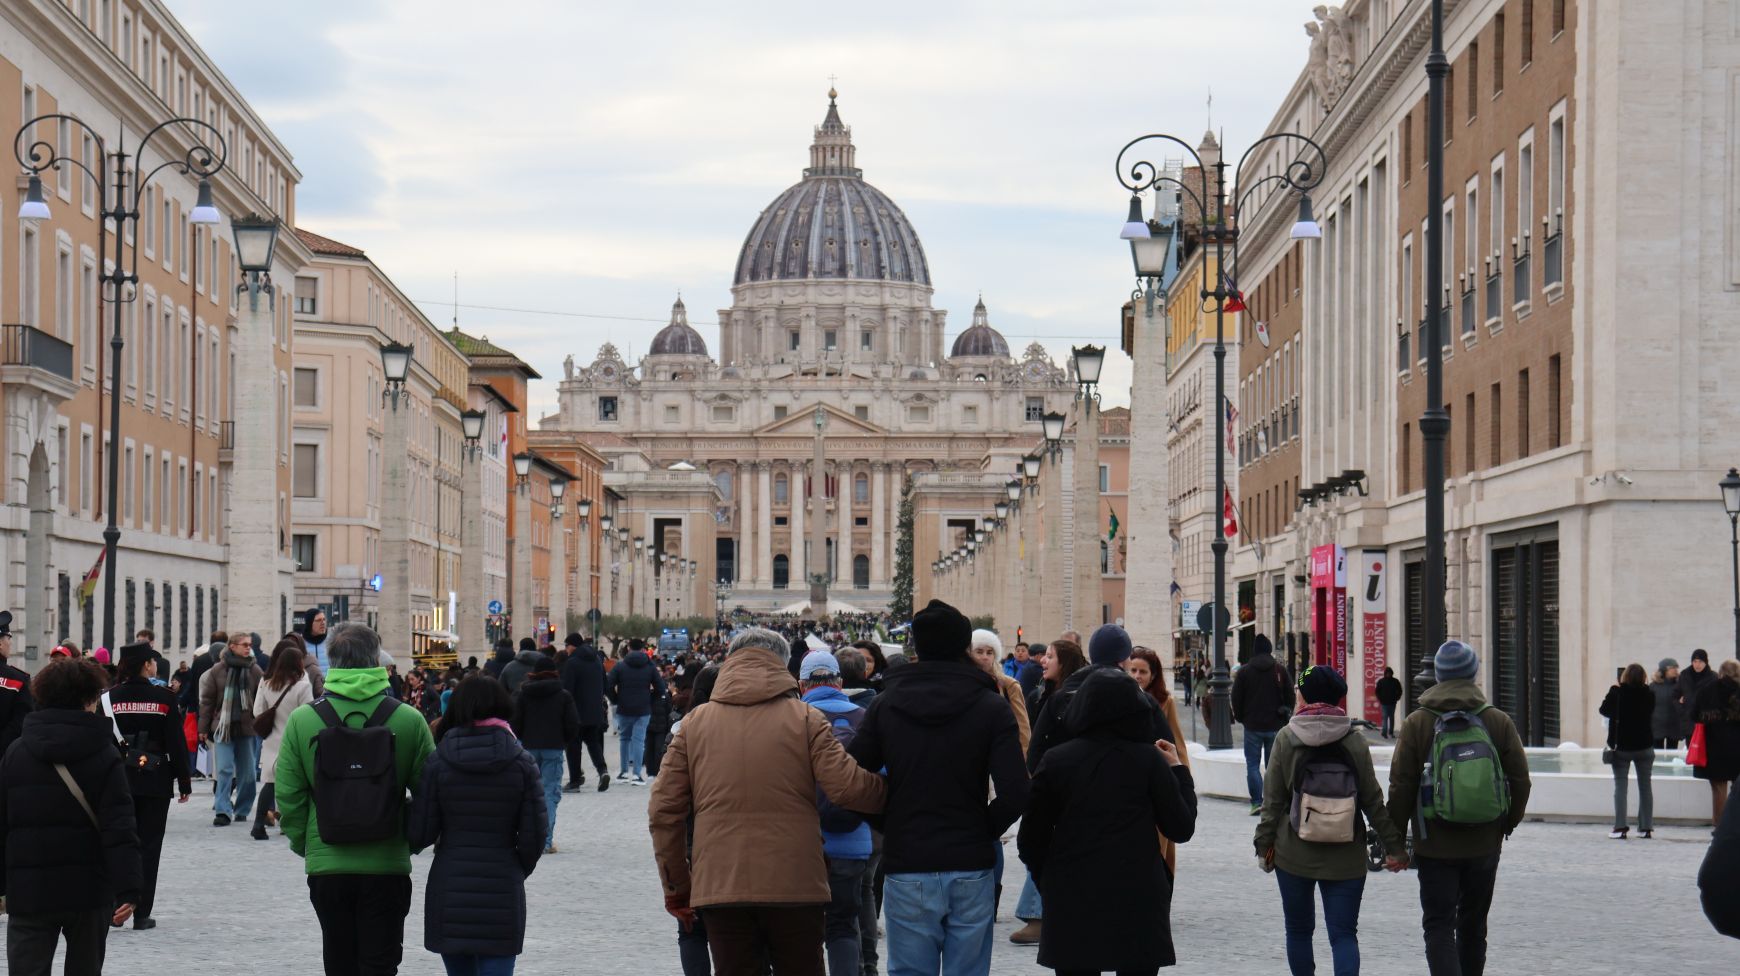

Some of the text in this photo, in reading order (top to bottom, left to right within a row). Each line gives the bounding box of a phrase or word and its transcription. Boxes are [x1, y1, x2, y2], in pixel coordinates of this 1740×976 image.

[1336, 593, 1345, 677] OURIST INFOPOINT
[1364, 618, 1374, 689] TOURIST
[112, 702, 159, 712] CARABINIERI
